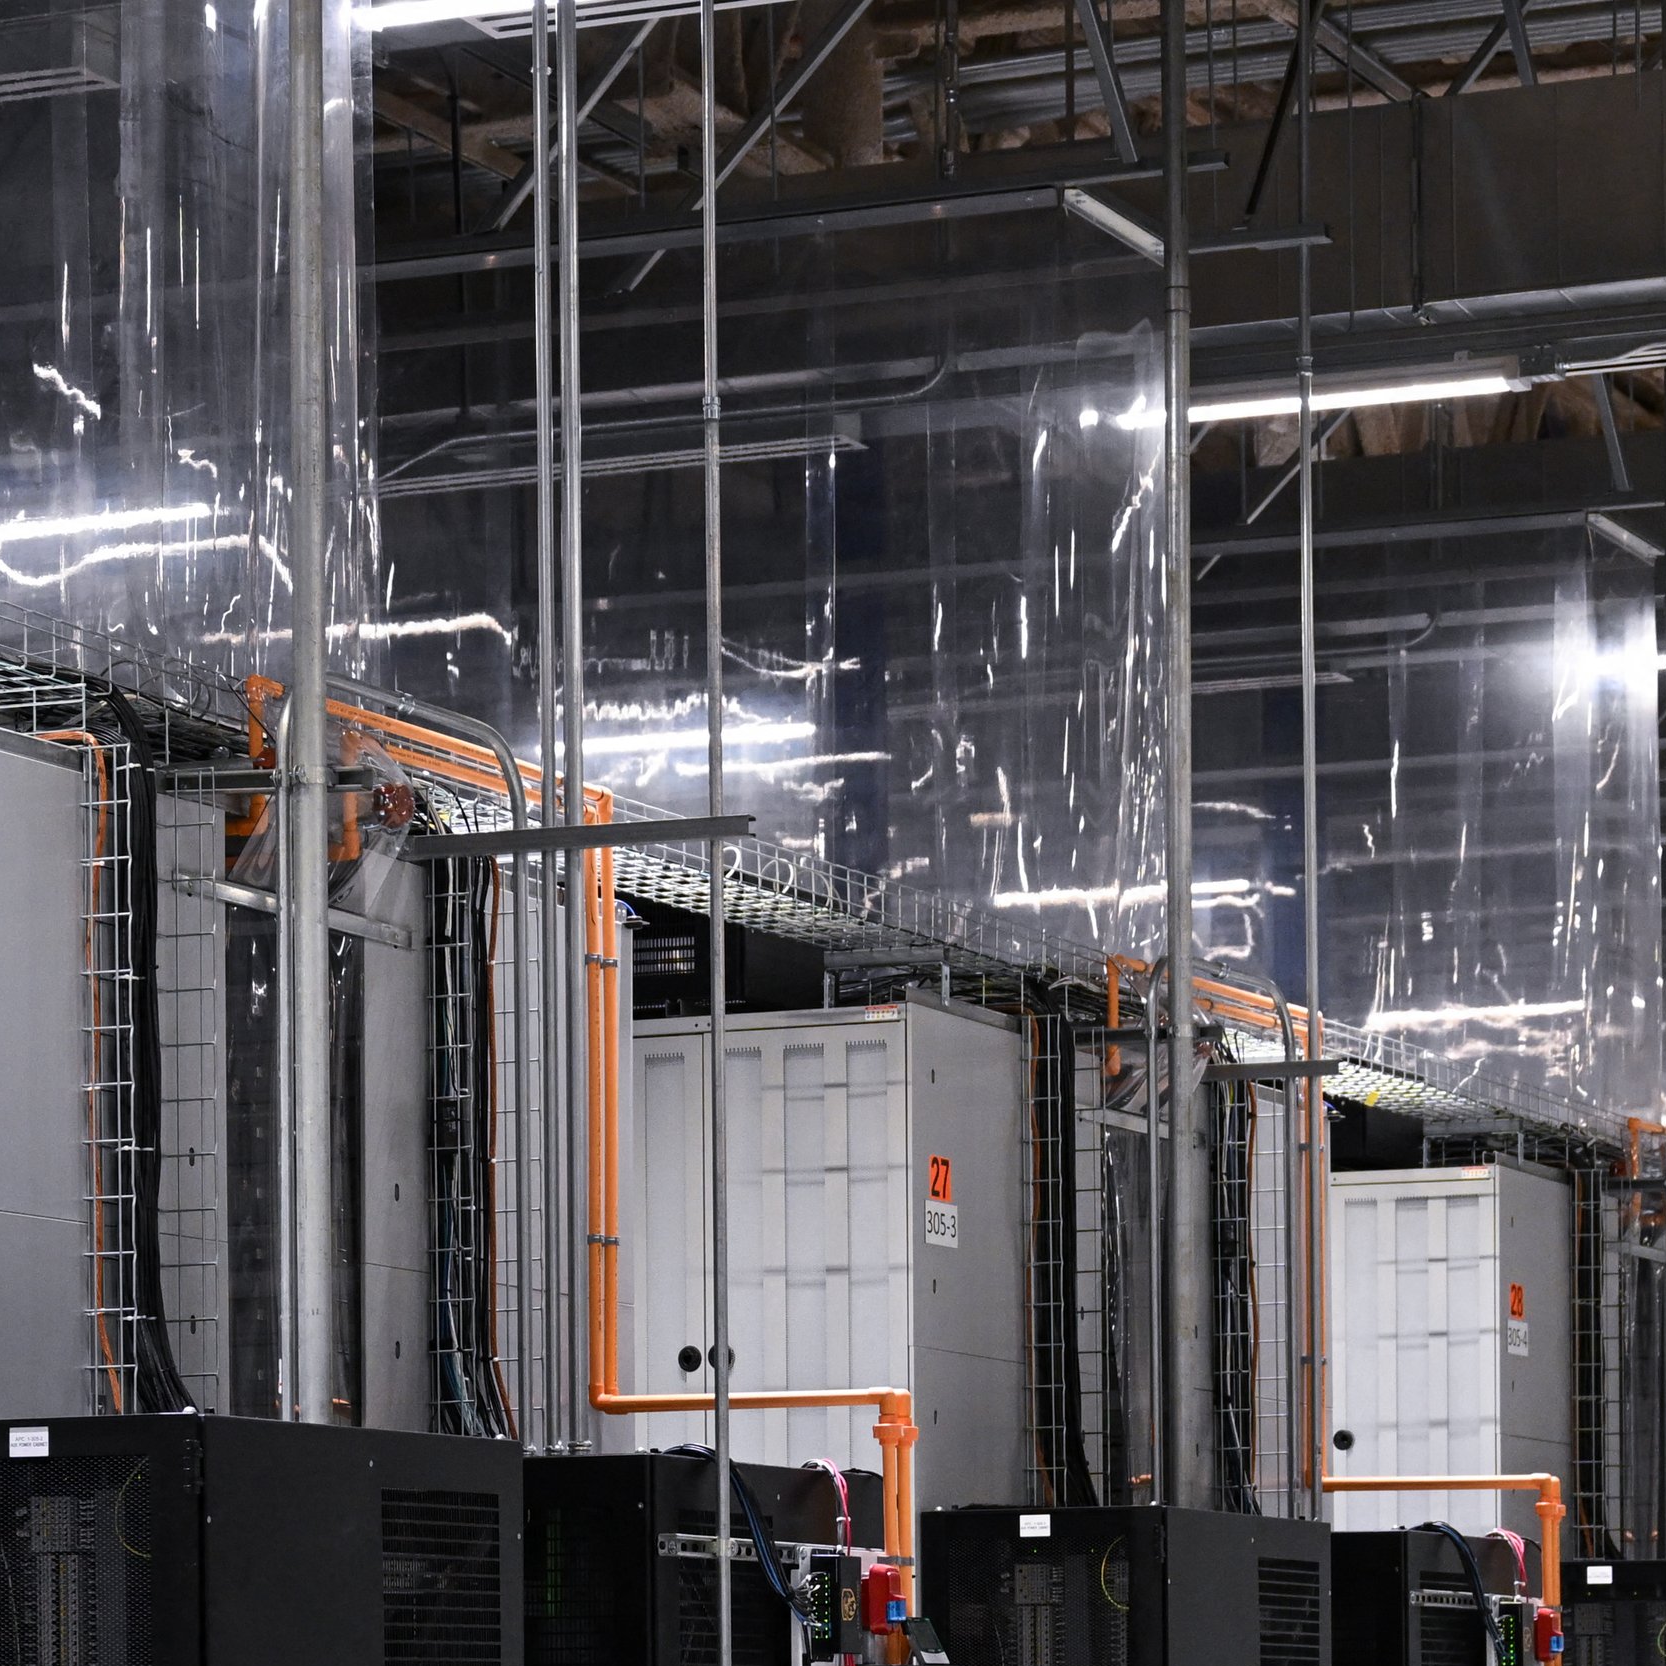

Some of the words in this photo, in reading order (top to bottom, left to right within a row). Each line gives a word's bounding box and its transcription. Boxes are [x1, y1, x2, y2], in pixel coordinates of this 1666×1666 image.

[931, 1156, 950, 1199] 27
[927, 1210, 957, 1238] 305-3
[1510, 1283, 1524, 1317] 28
[1508, 1327, 1527, 1348] 305-4
